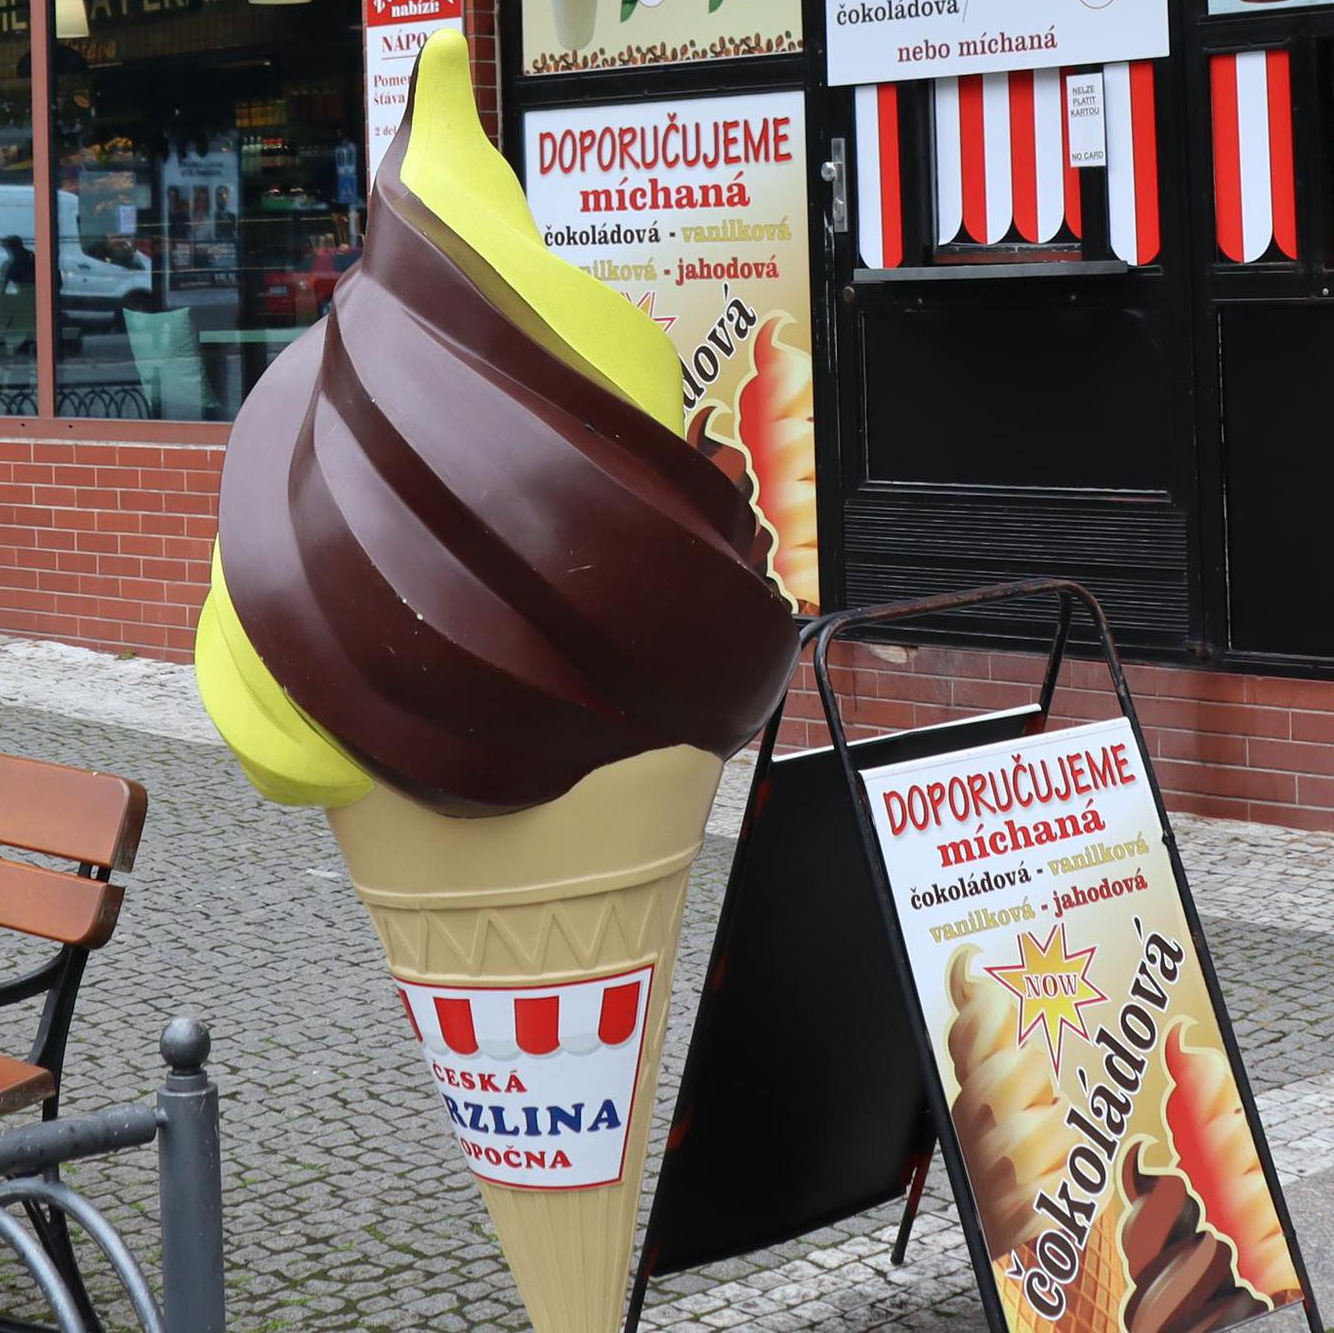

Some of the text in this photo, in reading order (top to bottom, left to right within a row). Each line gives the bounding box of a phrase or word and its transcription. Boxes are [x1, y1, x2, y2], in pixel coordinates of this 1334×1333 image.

[381, 28, 434, 54] NÁPO
[898, 25, 1057, 62] nebo míchaná
[1073, 96, 1095, 106] PLATIT
[539, 112, 793, 175] DOPORUČUJEME
[580, 170, 751, 213] míchaná
[544, 220, 660, 246] čokoládová
[682, 215, 792, 243] vanilková
[675, 254, 780, 287] jahodová
[883, 742, 1136, 836] DOPORUČUJEME
[937, 798, 1106, 868] míchaná
[910, 860, 1032, 910] čokoládová
[1048, 831, 1149, 876] vanilková
[929, 896, 1036, 943] vanilková
[1053, 867, 1148, 918] jahodová
[1025, 974, 1079, 998] NOW
[432, 1060, 527, 1093] ČESKÁ
[442, 1092, 621, 1137] RZLINA
[1008, 916, 1184, 1321] čokoládová
